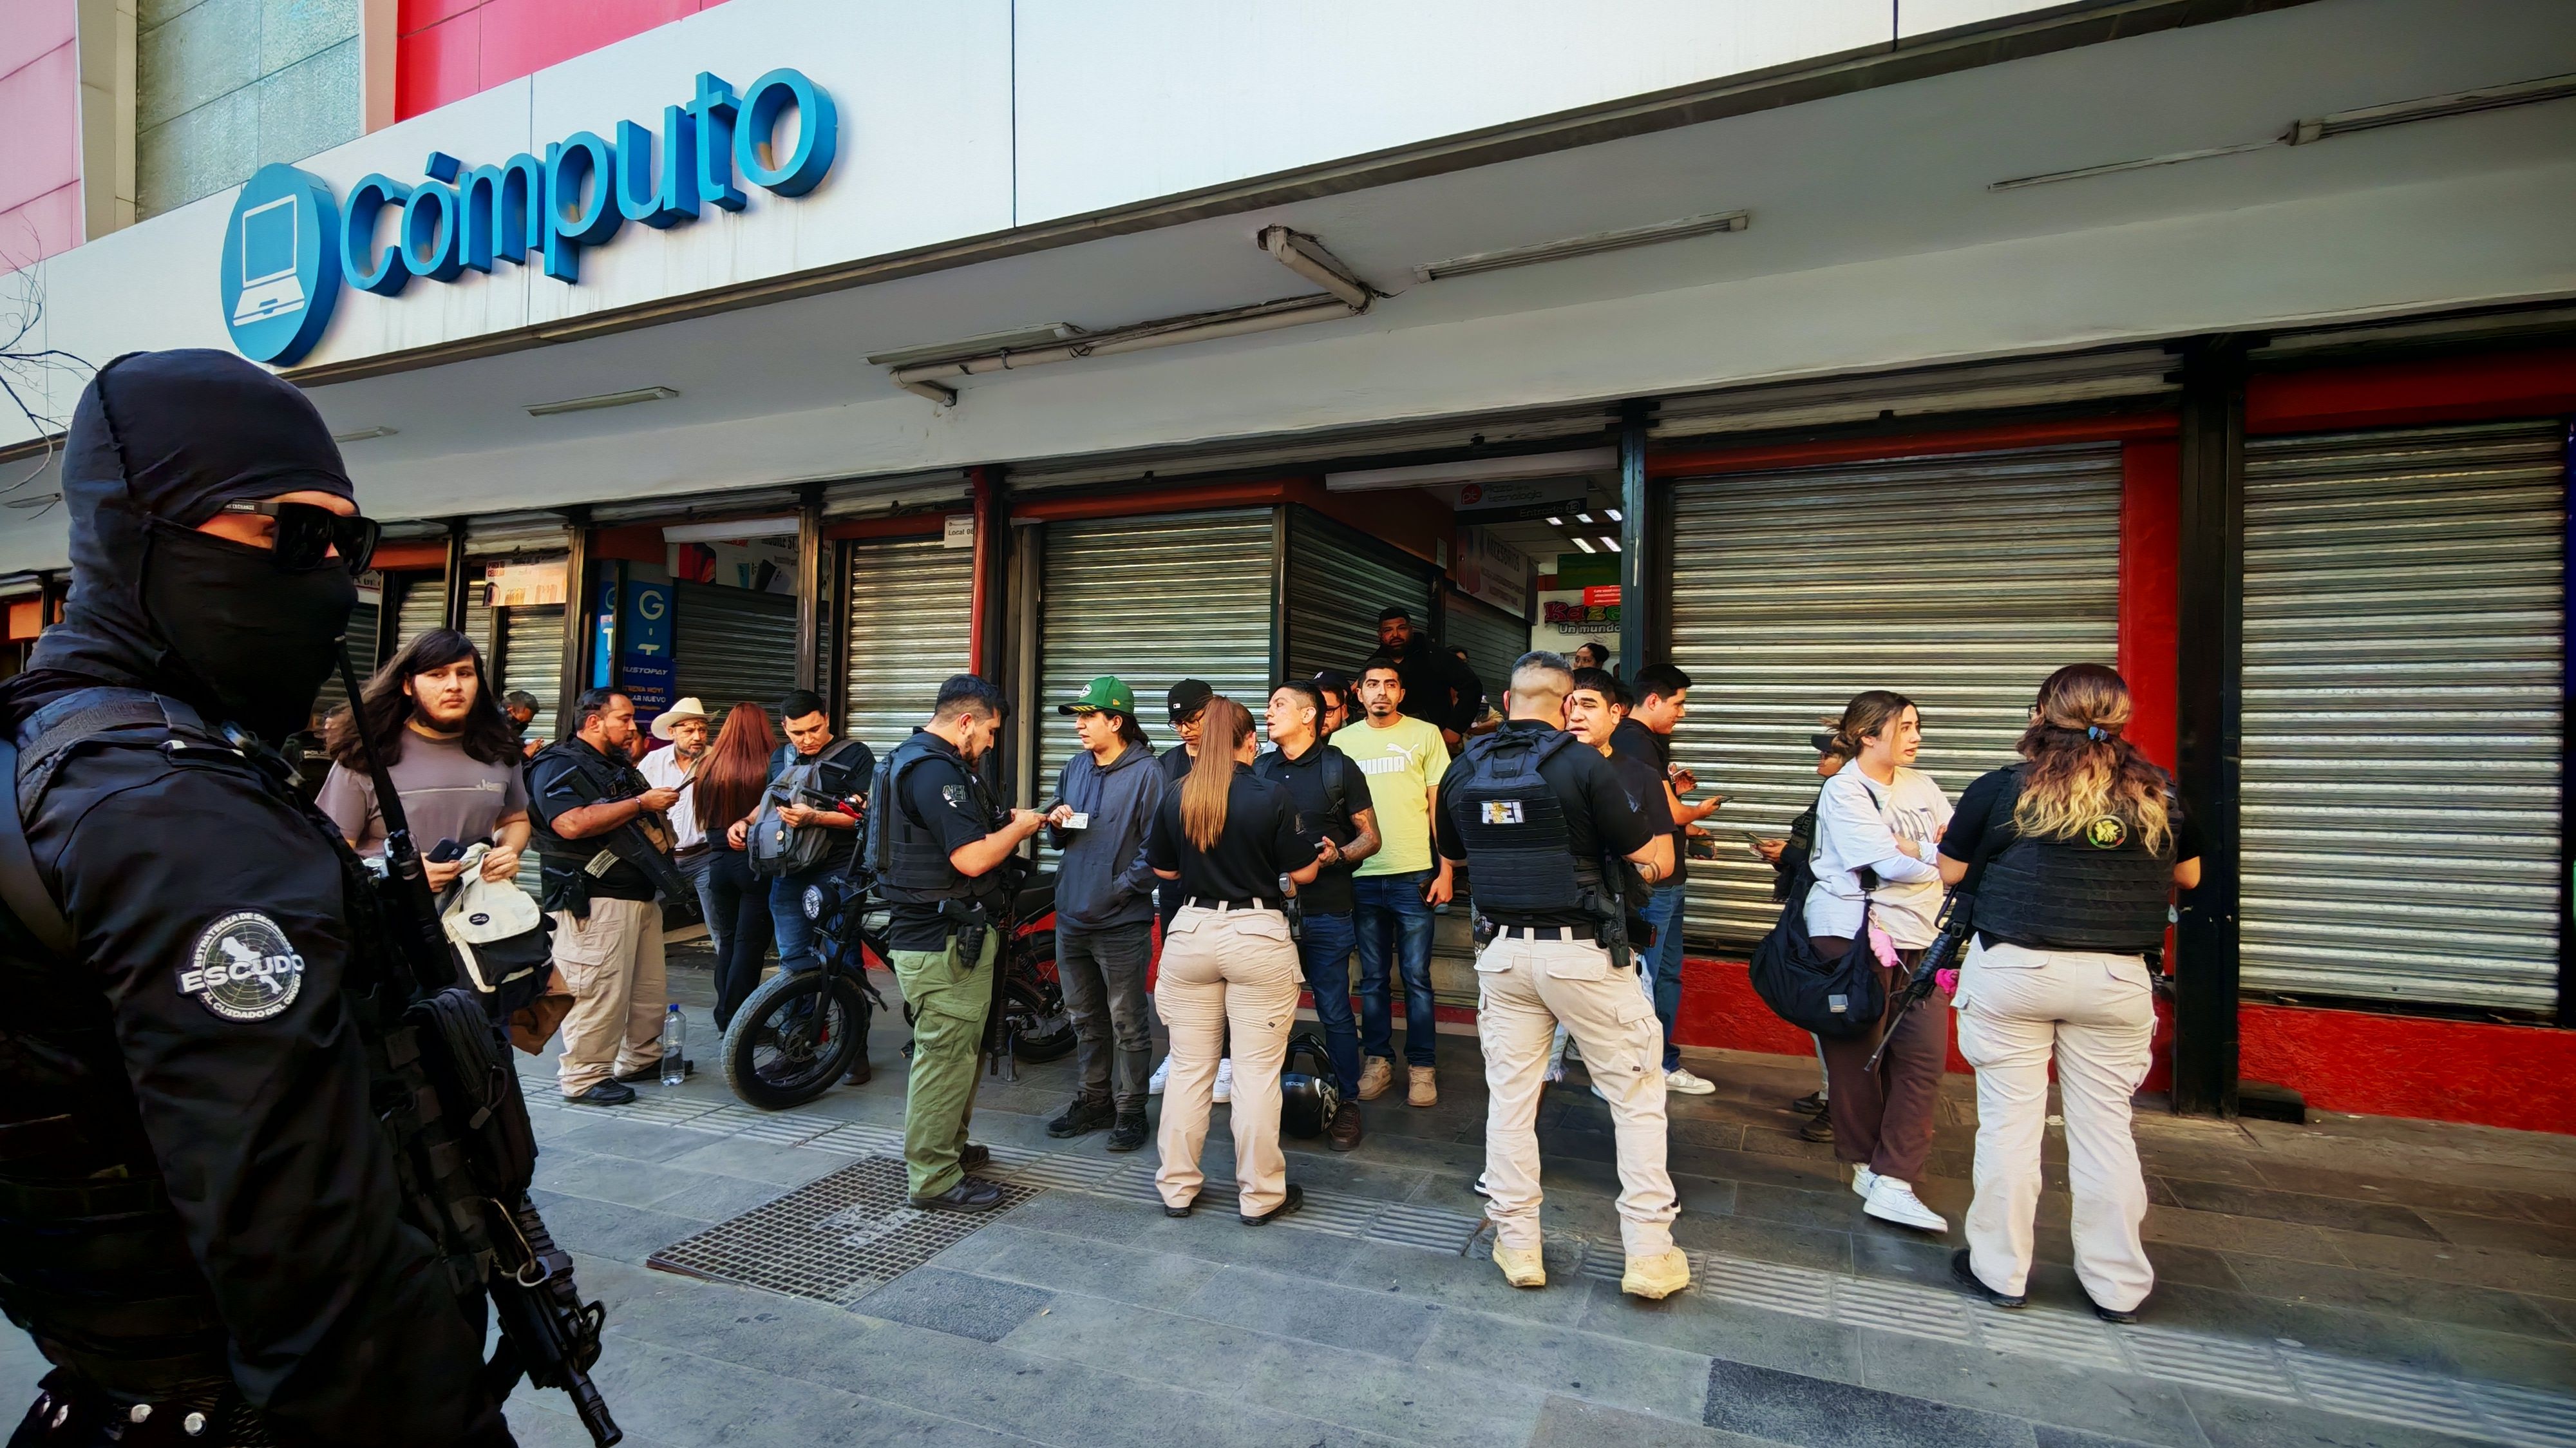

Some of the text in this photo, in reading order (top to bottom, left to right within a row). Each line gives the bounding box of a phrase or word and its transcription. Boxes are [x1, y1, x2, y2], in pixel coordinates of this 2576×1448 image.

[340, 67, 837, 284] Cómputo
[1558, 623, 1577, 634] Un
[643, 695, 666, 703] NUEVO
[193, 914, 238, 967] ESTRATEGIA
[181, 954, 305, 993] ESCUDO
[201, 991, 213, 1005] AL
[213, 1003, 265, 1018] CUIDADO
[265, 1004, 286, 1016] DEL
